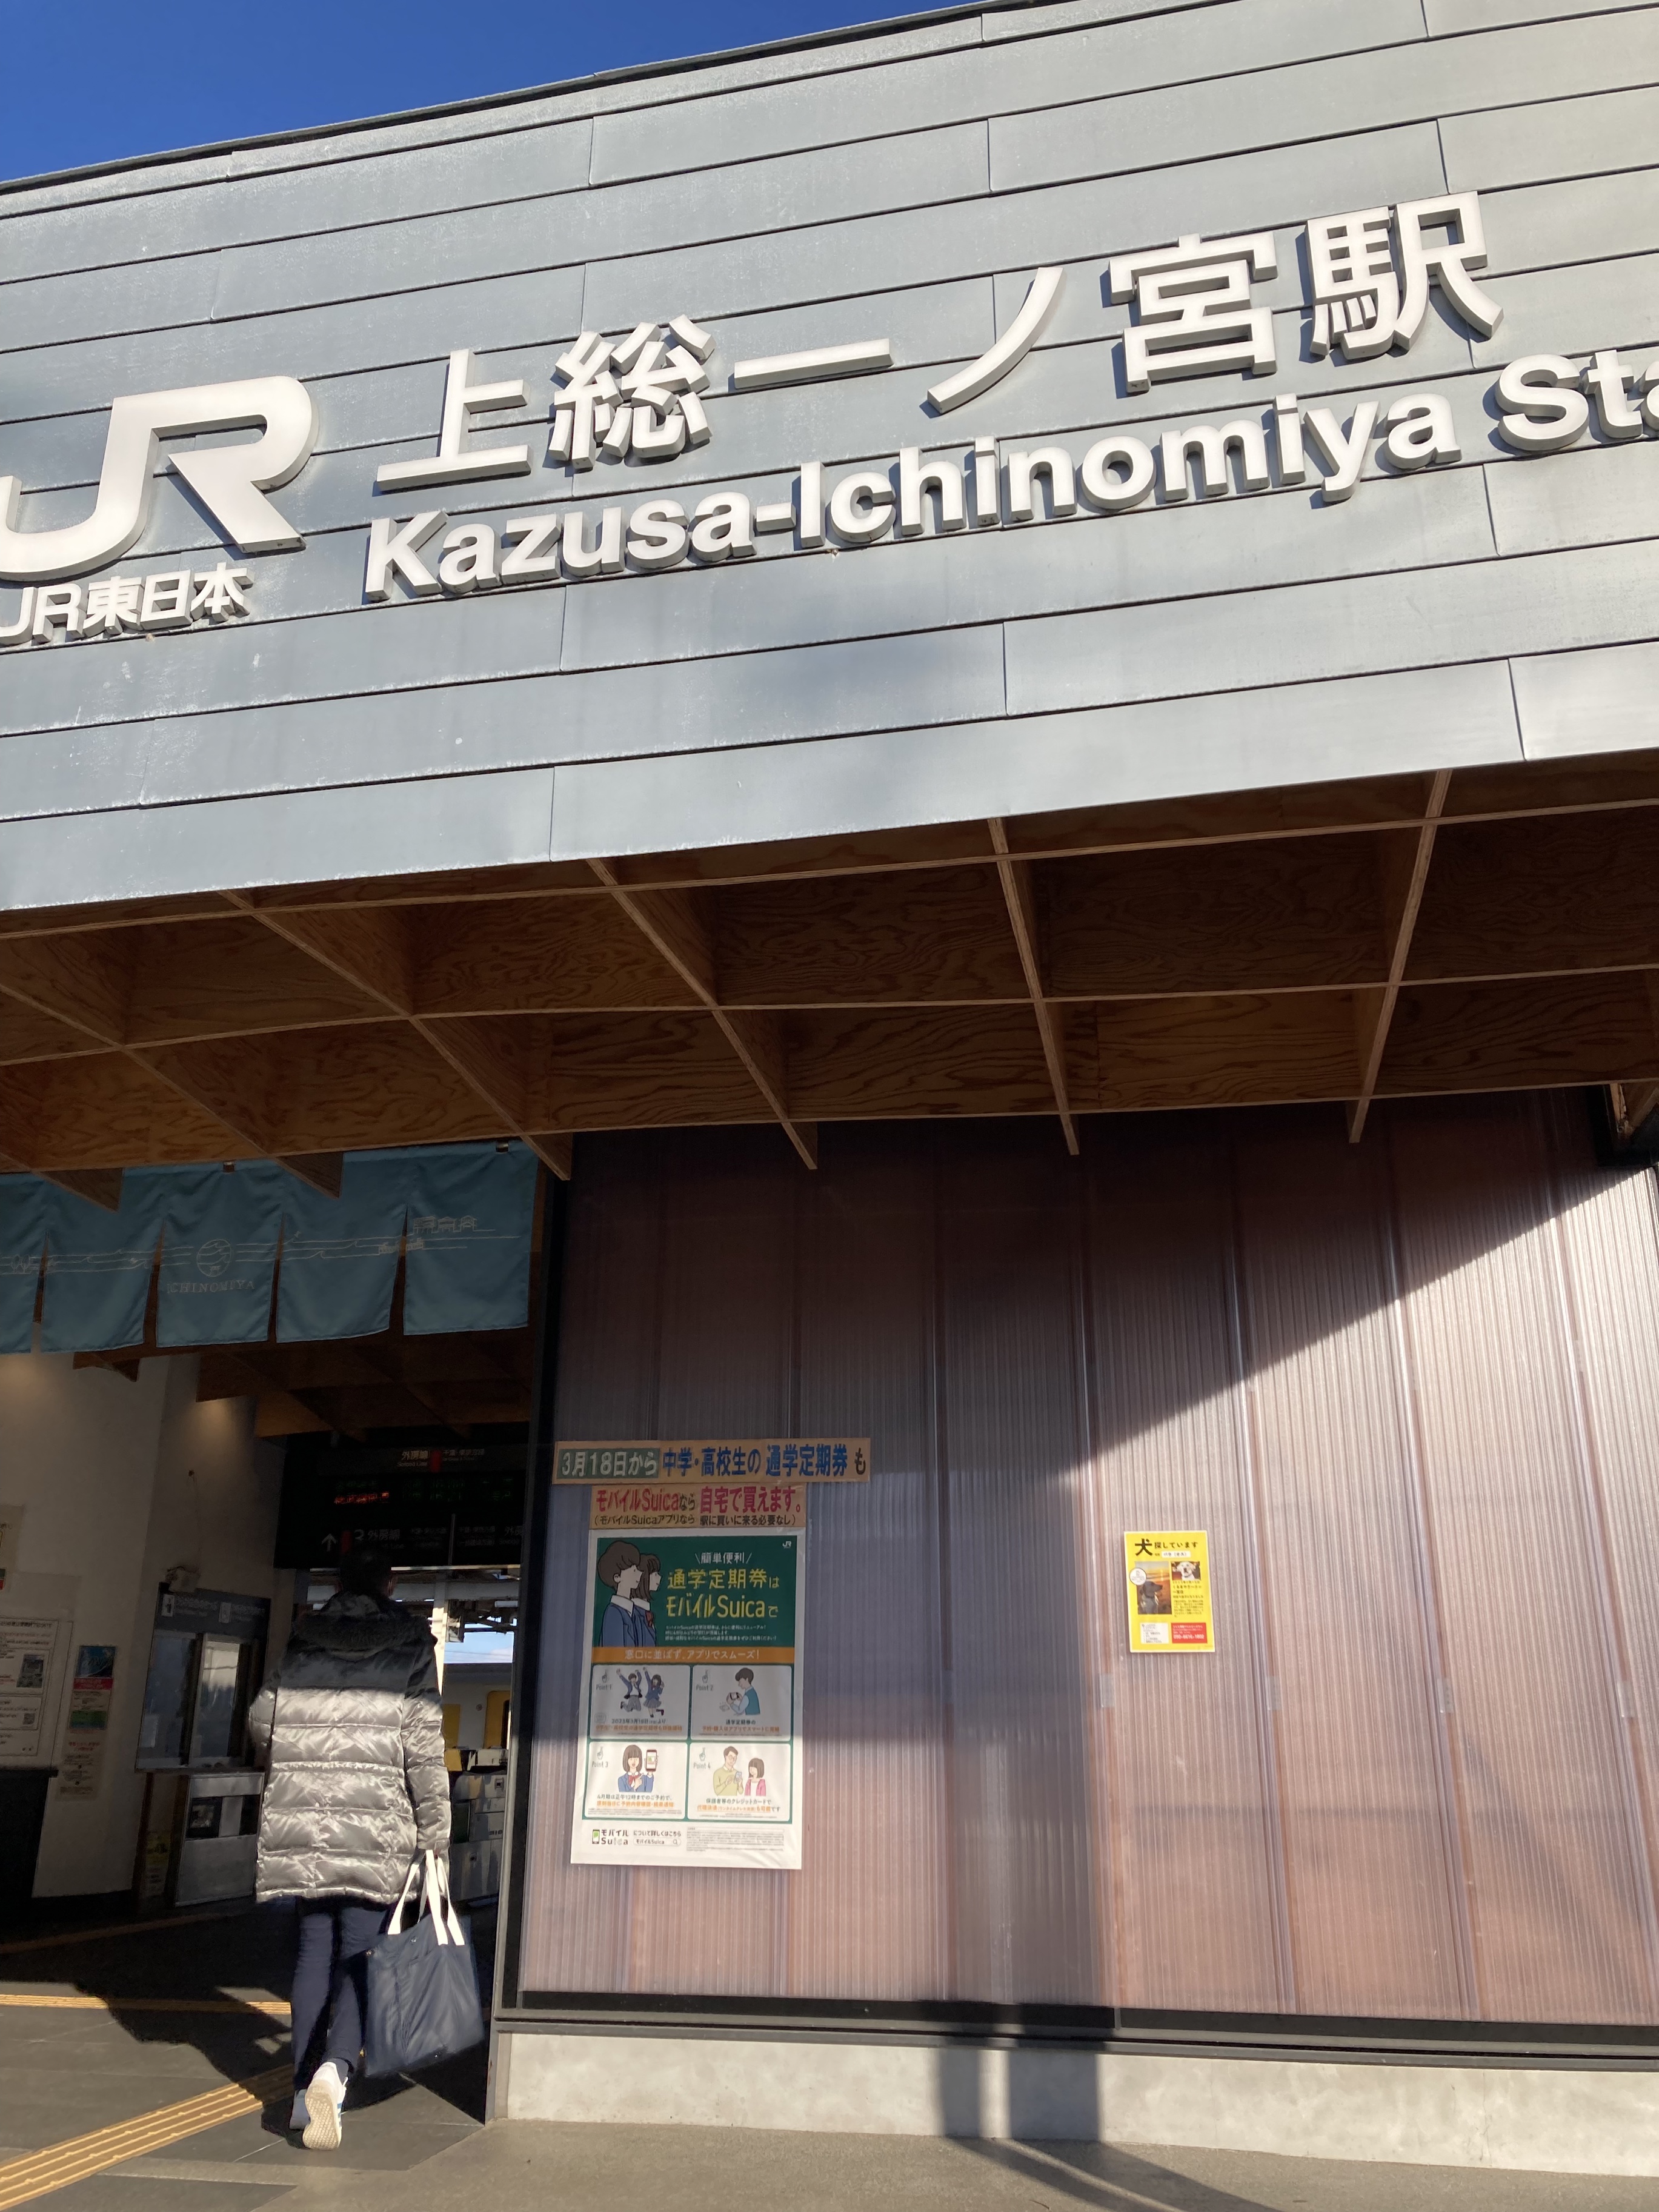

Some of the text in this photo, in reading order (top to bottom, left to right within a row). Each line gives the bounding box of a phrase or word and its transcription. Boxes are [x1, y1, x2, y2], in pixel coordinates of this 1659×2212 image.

[376, 191, 1504, 486] 上総一ノ宮駅
[0, 376, 315, 579] JR
[365, 394, 1461, 602] Kazusa-Ichinomiya
[0, 562, 254, 646] JR東日本
[166, 1280, 255, 1294] ICHINOMIYA
[561, 1444, 866, 1477] 3月18日から 中学・高校生の 通学定期券 も
[596, 1486, 802, 1513] モバイルSuicaなら 自宅で買えます。
[700, 1552, 745, 1564] 簡単便利
[1135, 1538, 1152, 1556] 犬
[667, 1568, 780, 1590] 通学定期券は
[666, 1593, 779, 1618] モバイルSuicaで
[600, 1837, 629, 1845] Suica
